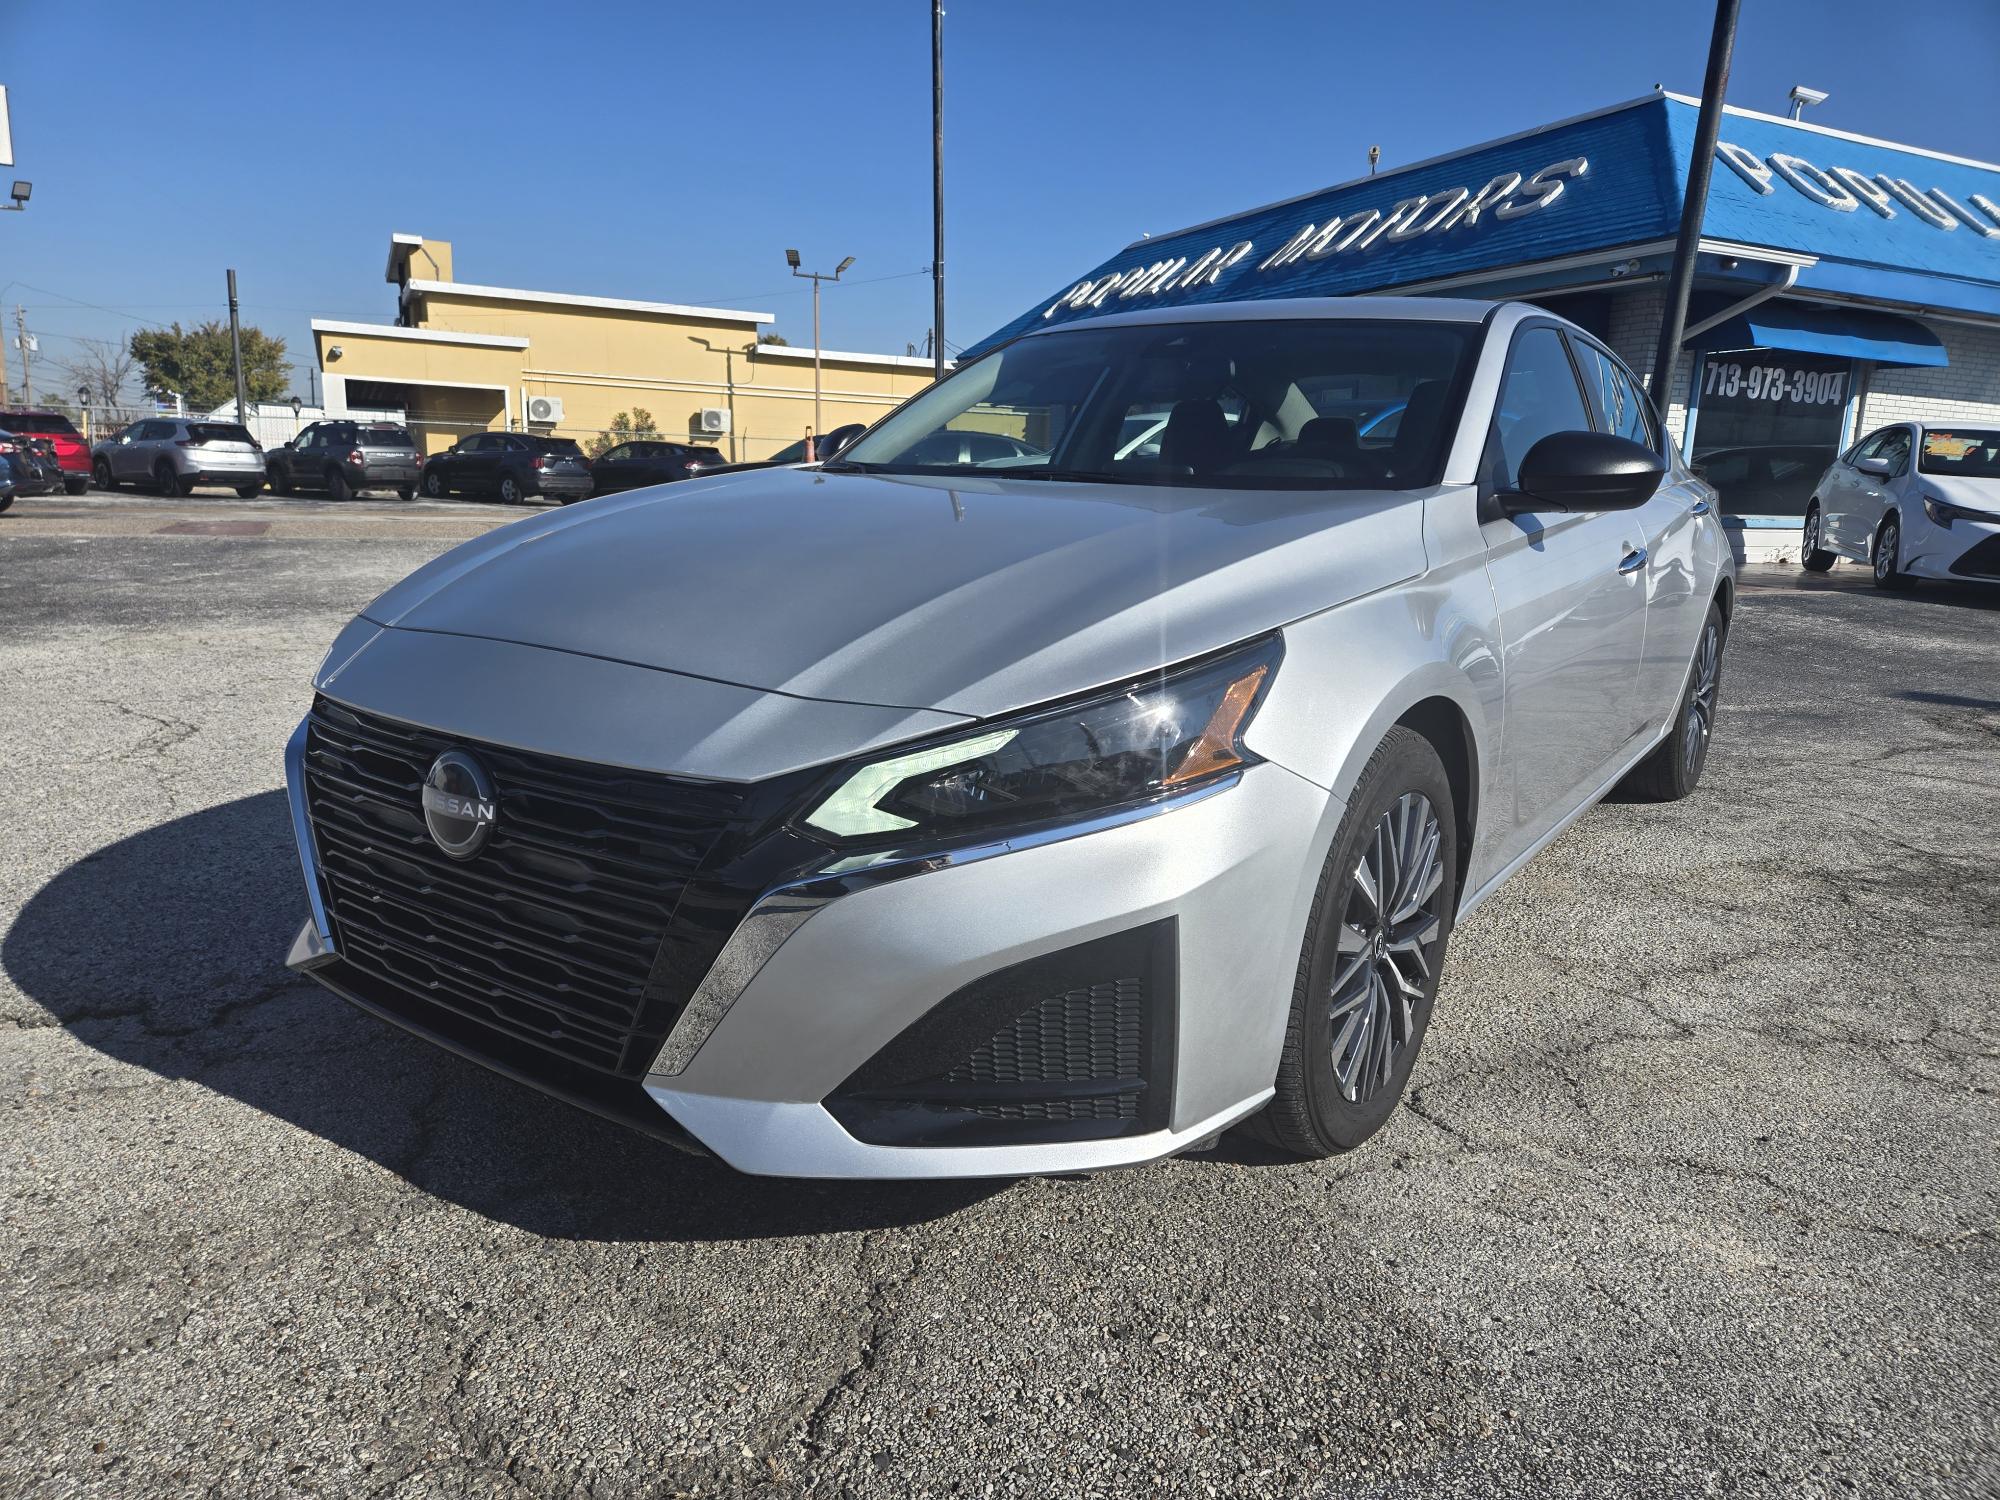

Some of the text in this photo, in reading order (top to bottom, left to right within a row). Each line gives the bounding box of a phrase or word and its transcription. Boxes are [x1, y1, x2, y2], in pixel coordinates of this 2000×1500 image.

[1043, 156, 1588, 319] POPULAR MOTORS
[1705, 362, 1847, 405] 713-973-3904
[424, 790, 494, 820] SSAN
